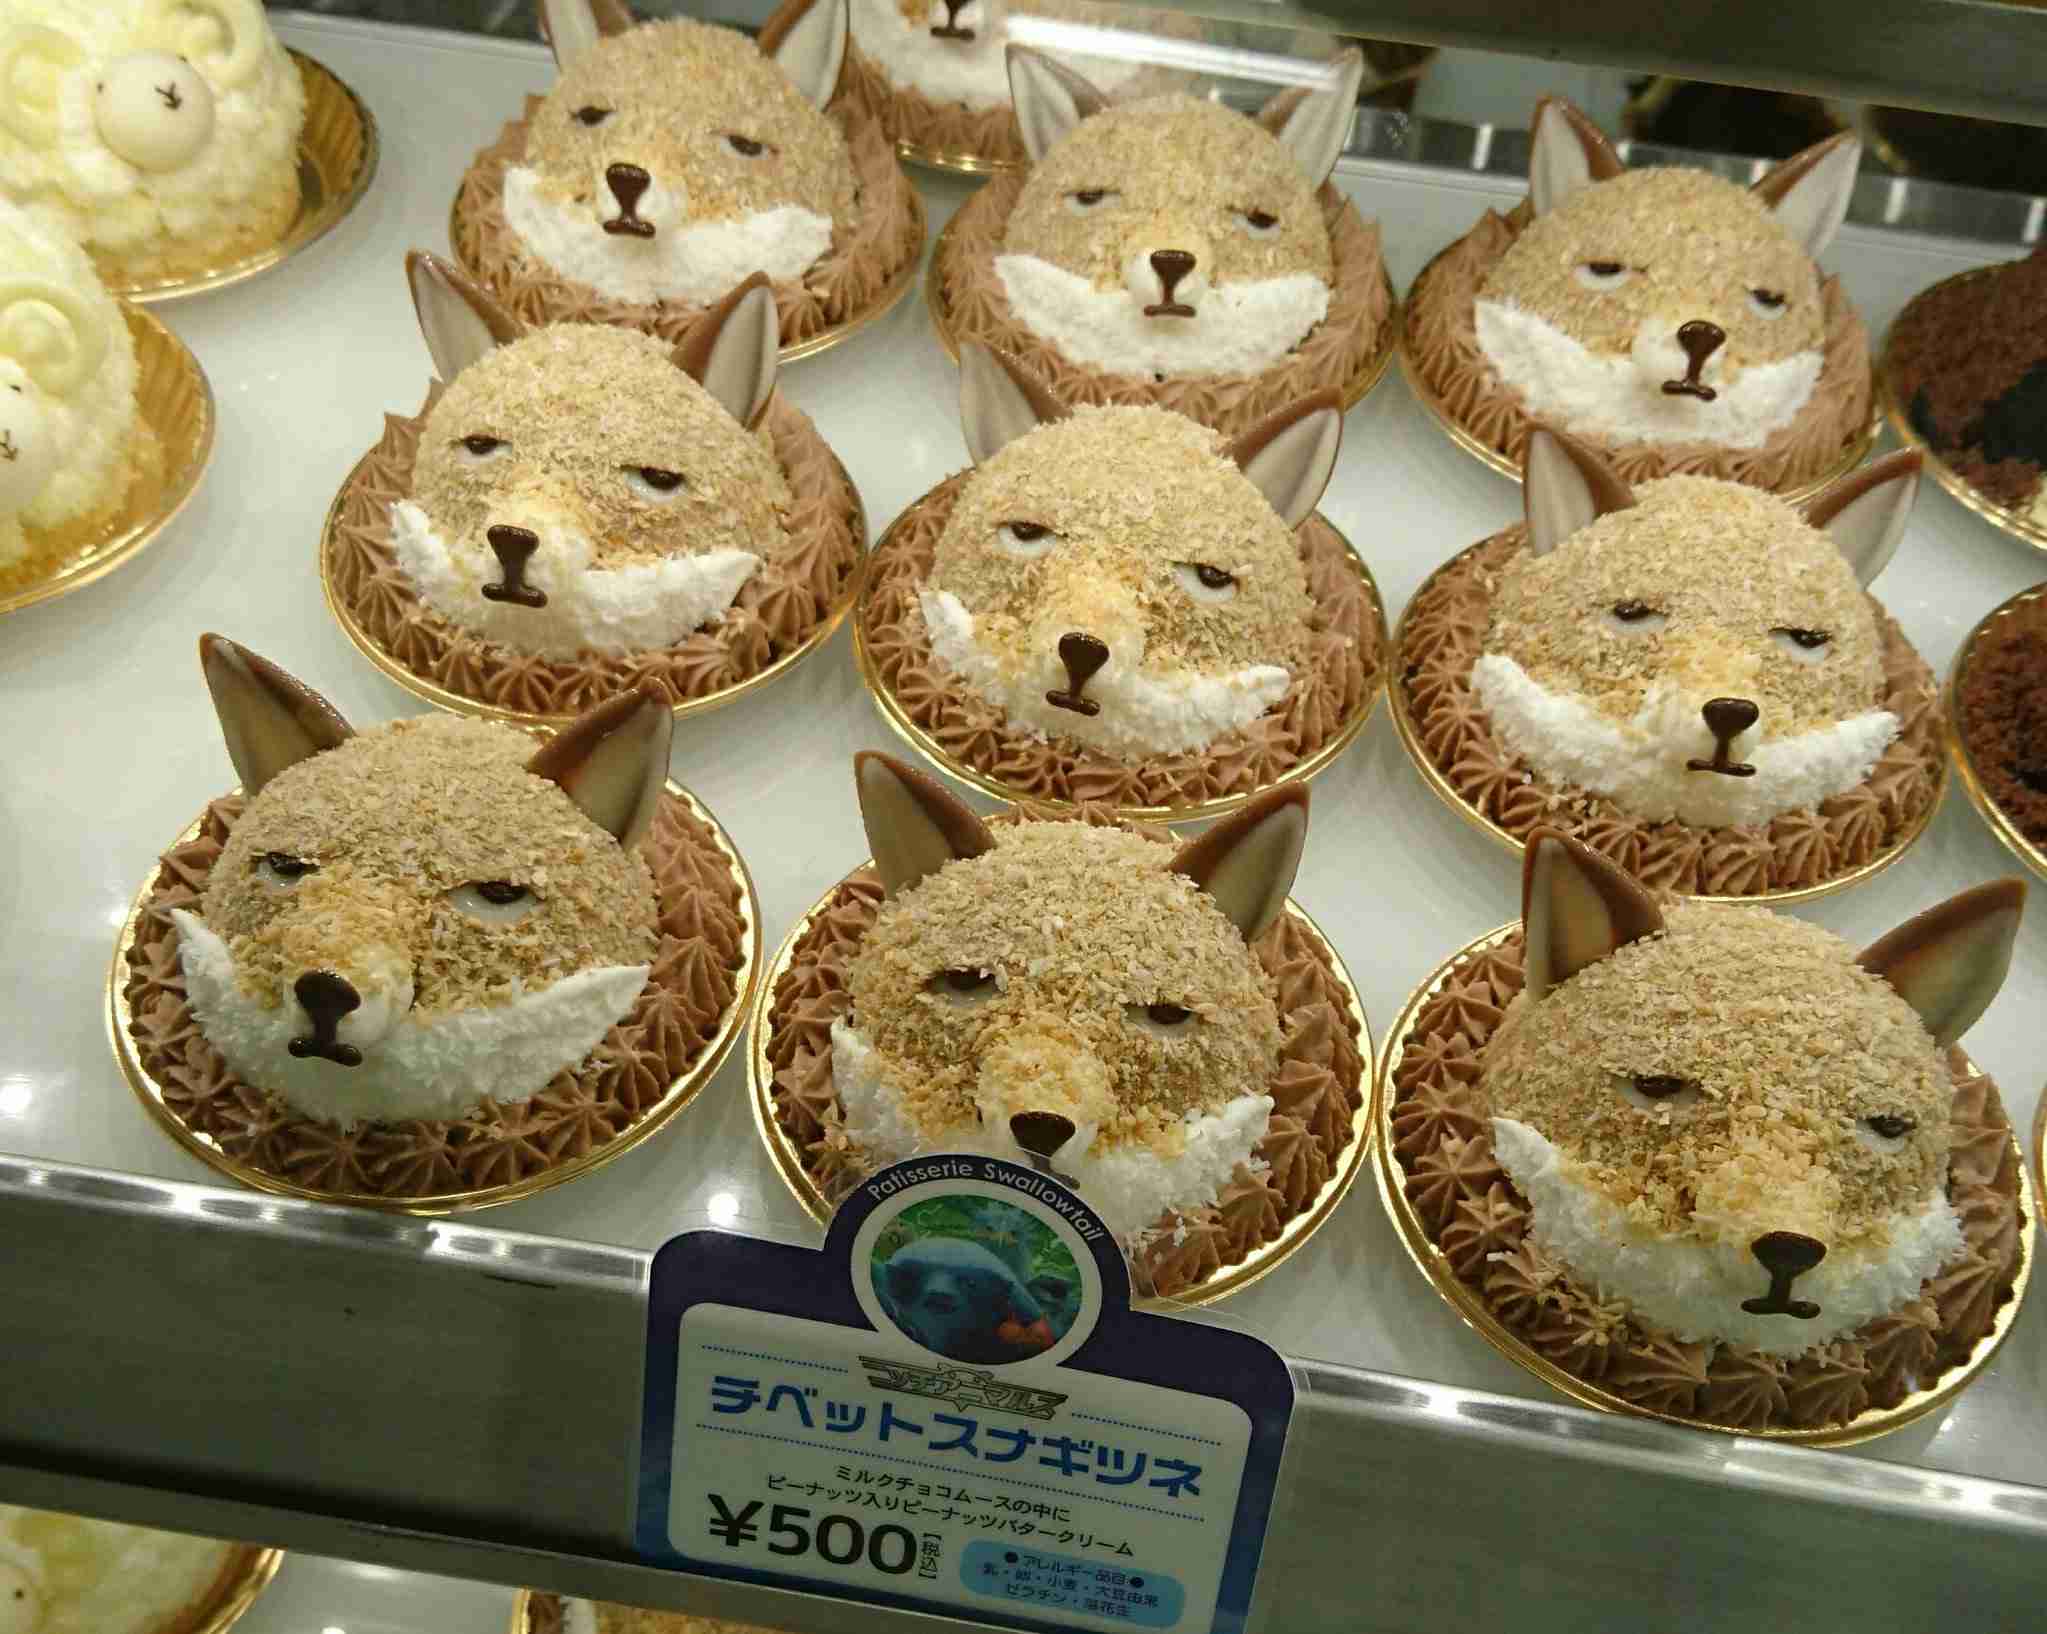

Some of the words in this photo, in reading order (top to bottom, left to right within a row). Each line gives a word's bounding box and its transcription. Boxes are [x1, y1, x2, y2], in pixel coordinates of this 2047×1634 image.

[867, 1160, 973, 1200] Patisserie
[983, 1163, 1105, 1242] Swallowtail
[711, 1375, 1203, 1498] チベットスナギツネ
[707, 1493, 918, 1575] ¥500
[767, 1473, 1135, 1557] ピーナッツ入りピーナッツバタークリーム
[836, 1464, 1072, 1523] ミルクチョコムースの中に
